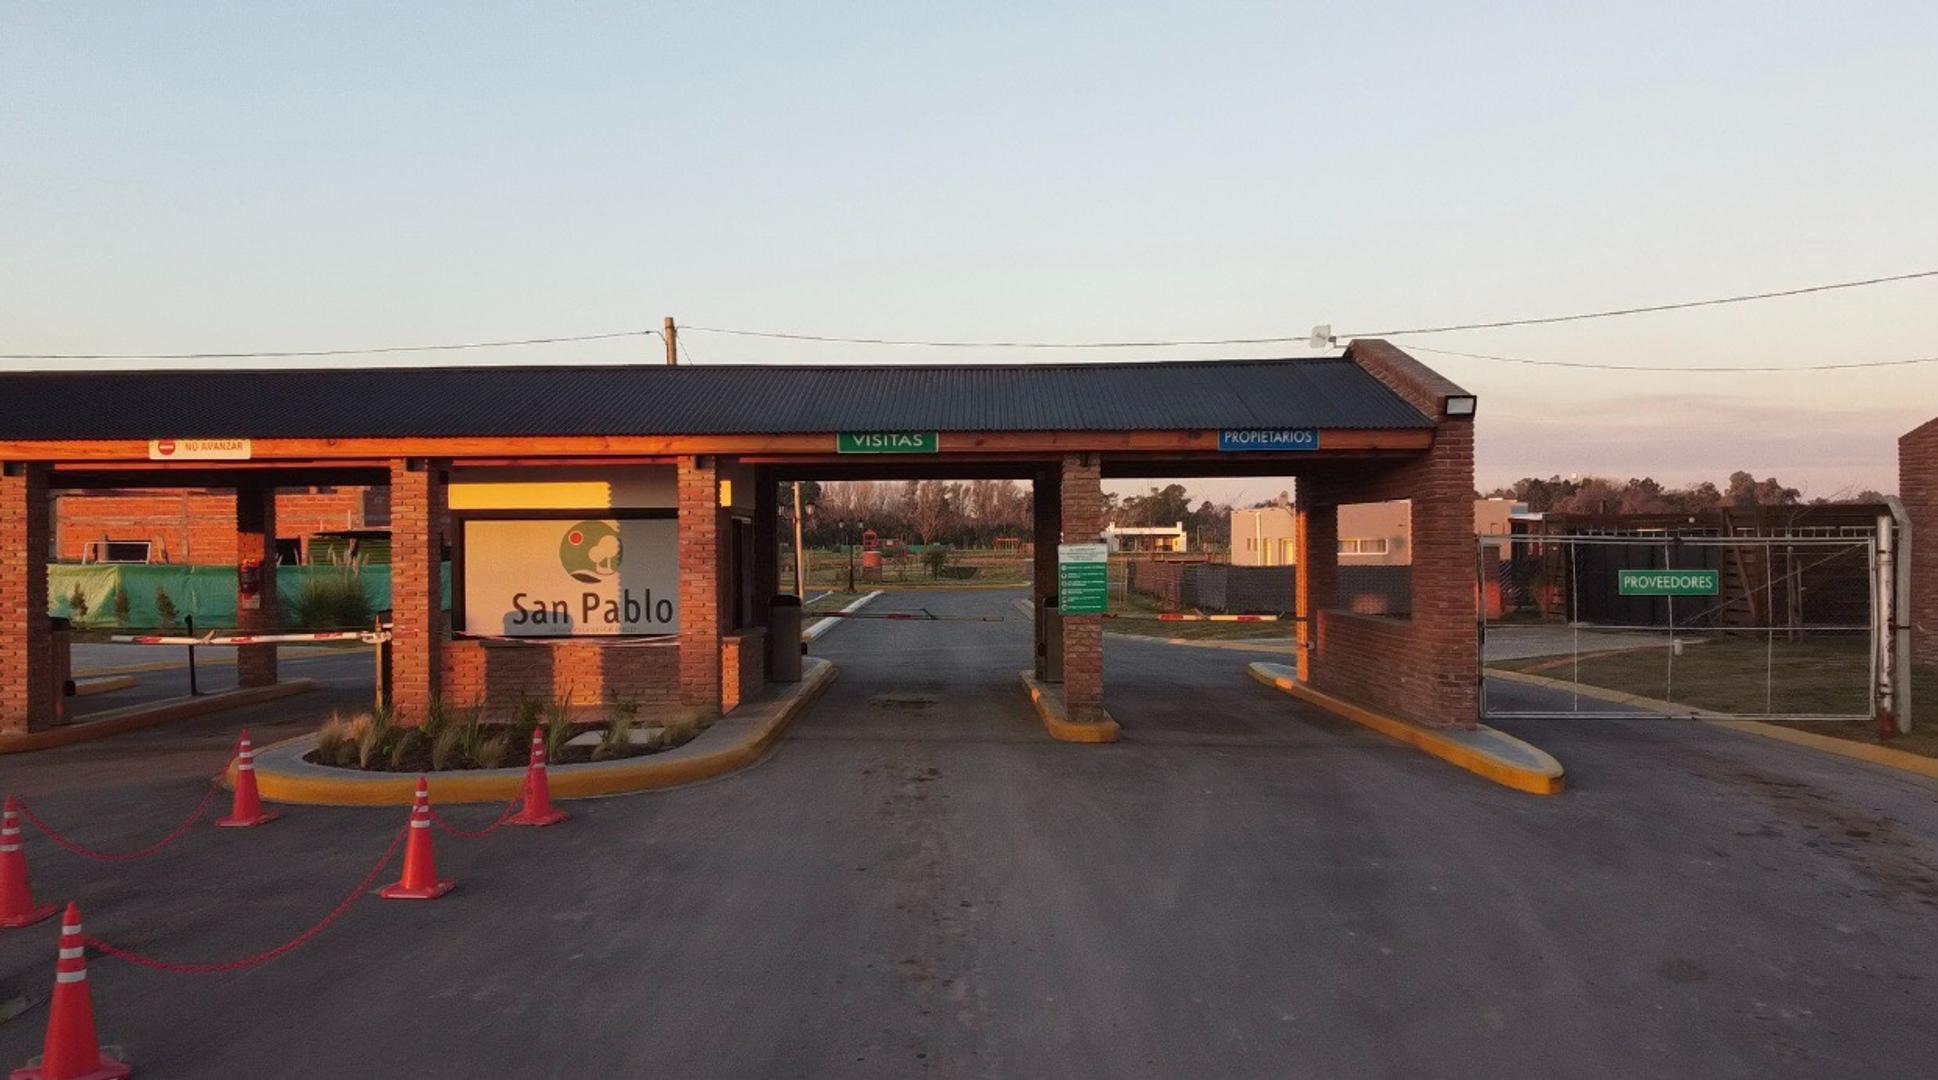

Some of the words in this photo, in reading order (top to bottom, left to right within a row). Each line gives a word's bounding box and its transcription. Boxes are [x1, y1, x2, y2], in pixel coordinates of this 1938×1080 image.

[853, 434, 923, 446] VISITAS
[1225, 430, 1312, 443] PROPIETARIOS
[185, 442, 198, 451] NO
[201, 441, 244, 451] AVANZAR
[1624, 576, 1713, 589] PROVEEDORES
[512, 592, 568, 625] San
[582, 588, 674, 624] Pablo
